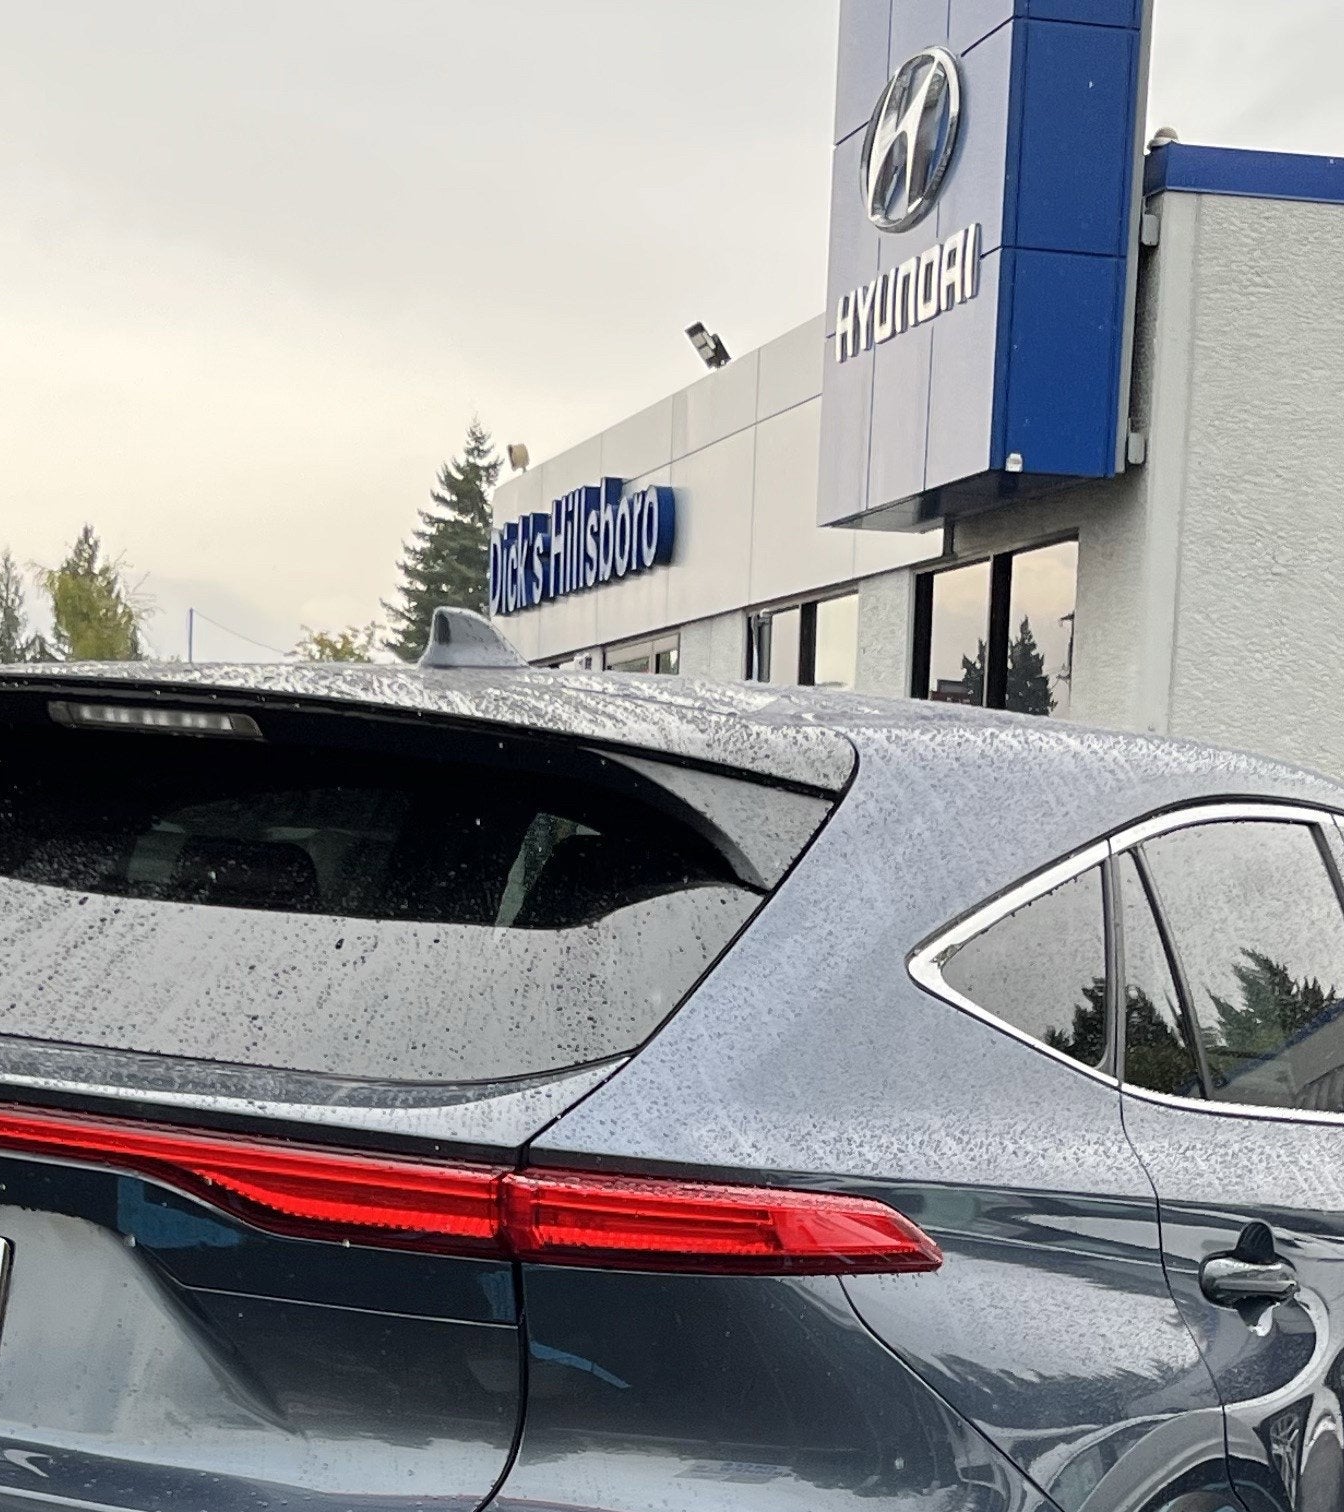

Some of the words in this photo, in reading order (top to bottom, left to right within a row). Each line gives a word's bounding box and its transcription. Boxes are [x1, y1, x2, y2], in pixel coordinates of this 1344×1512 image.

[835, 222, 981, 363] HYUNDAI
[488, 512, 545, 616] Dick's
[549, 477, 668, 598] Hillsboro
